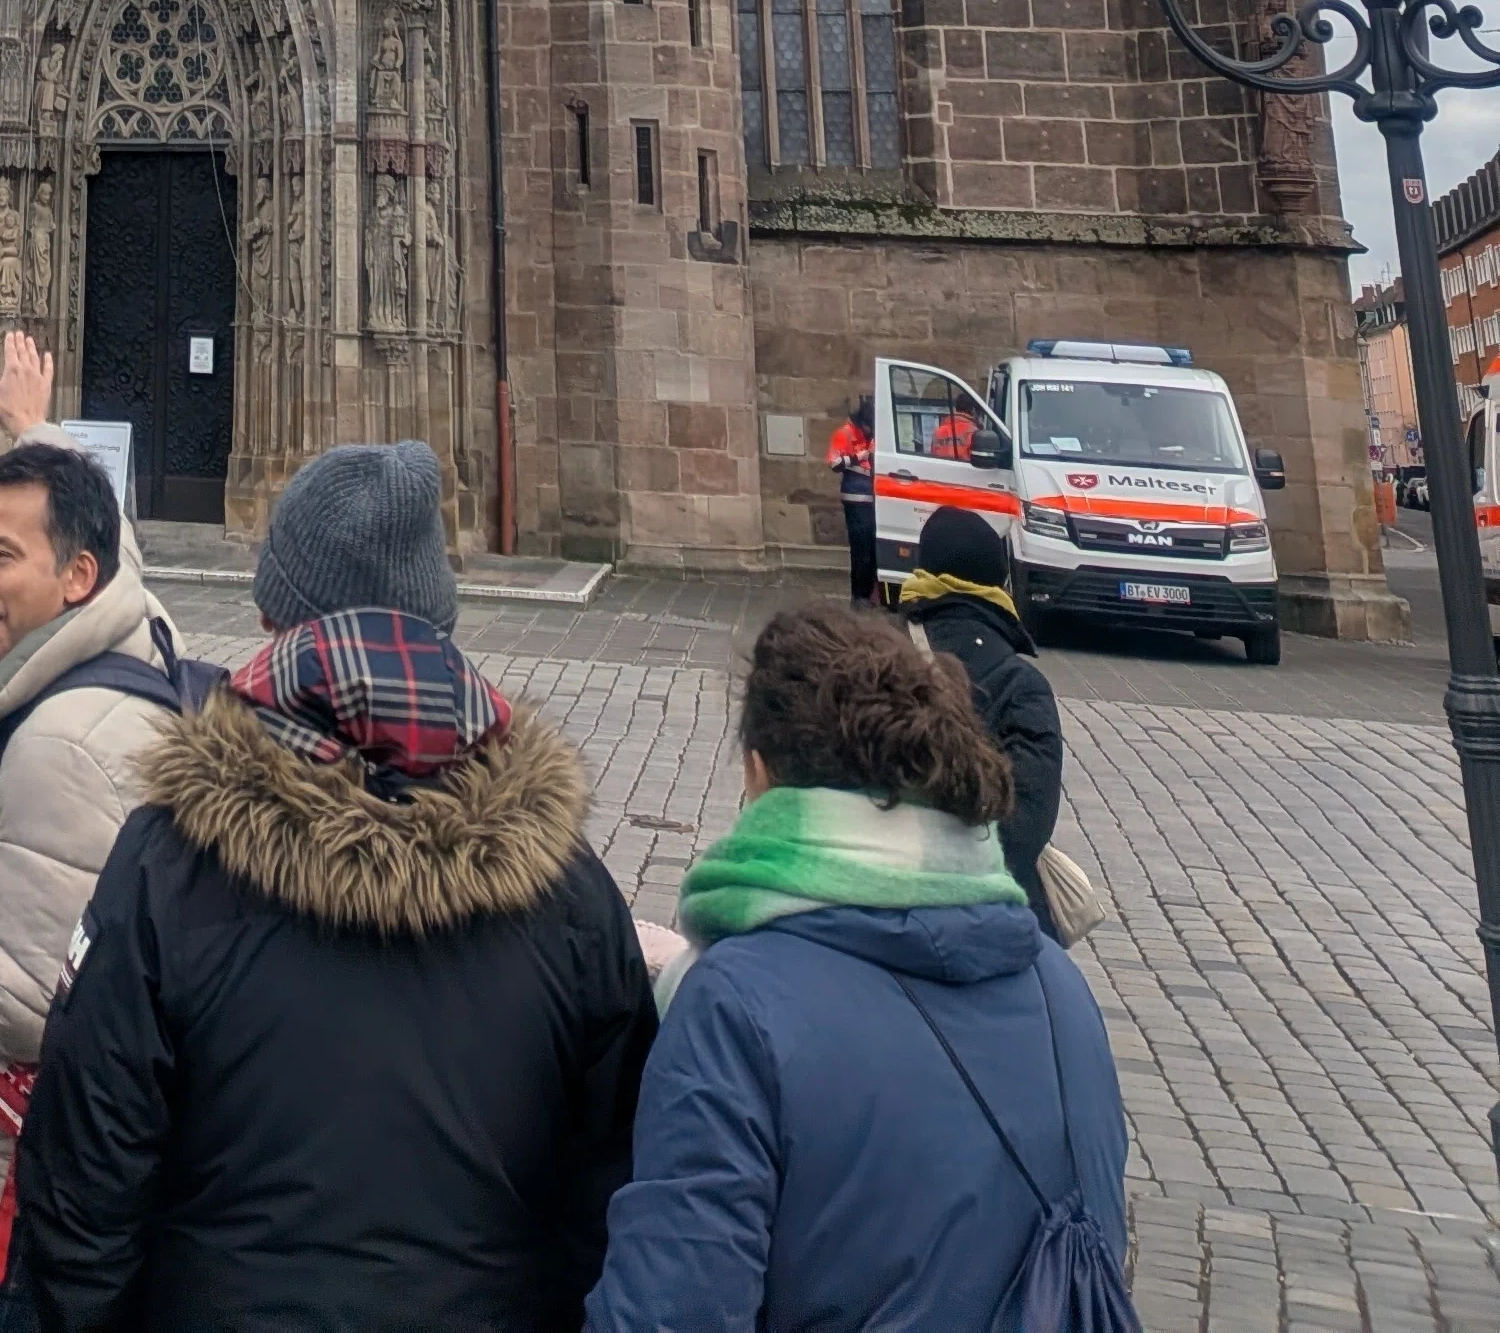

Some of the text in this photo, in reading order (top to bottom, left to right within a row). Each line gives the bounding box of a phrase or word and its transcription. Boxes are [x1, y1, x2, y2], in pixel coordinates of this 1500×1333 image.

[1108, 474, 1216, 495] Malteser
[1128, 533, 1172, 546] MAN
[1127, 585, 1187, 600] BT EV 3000
